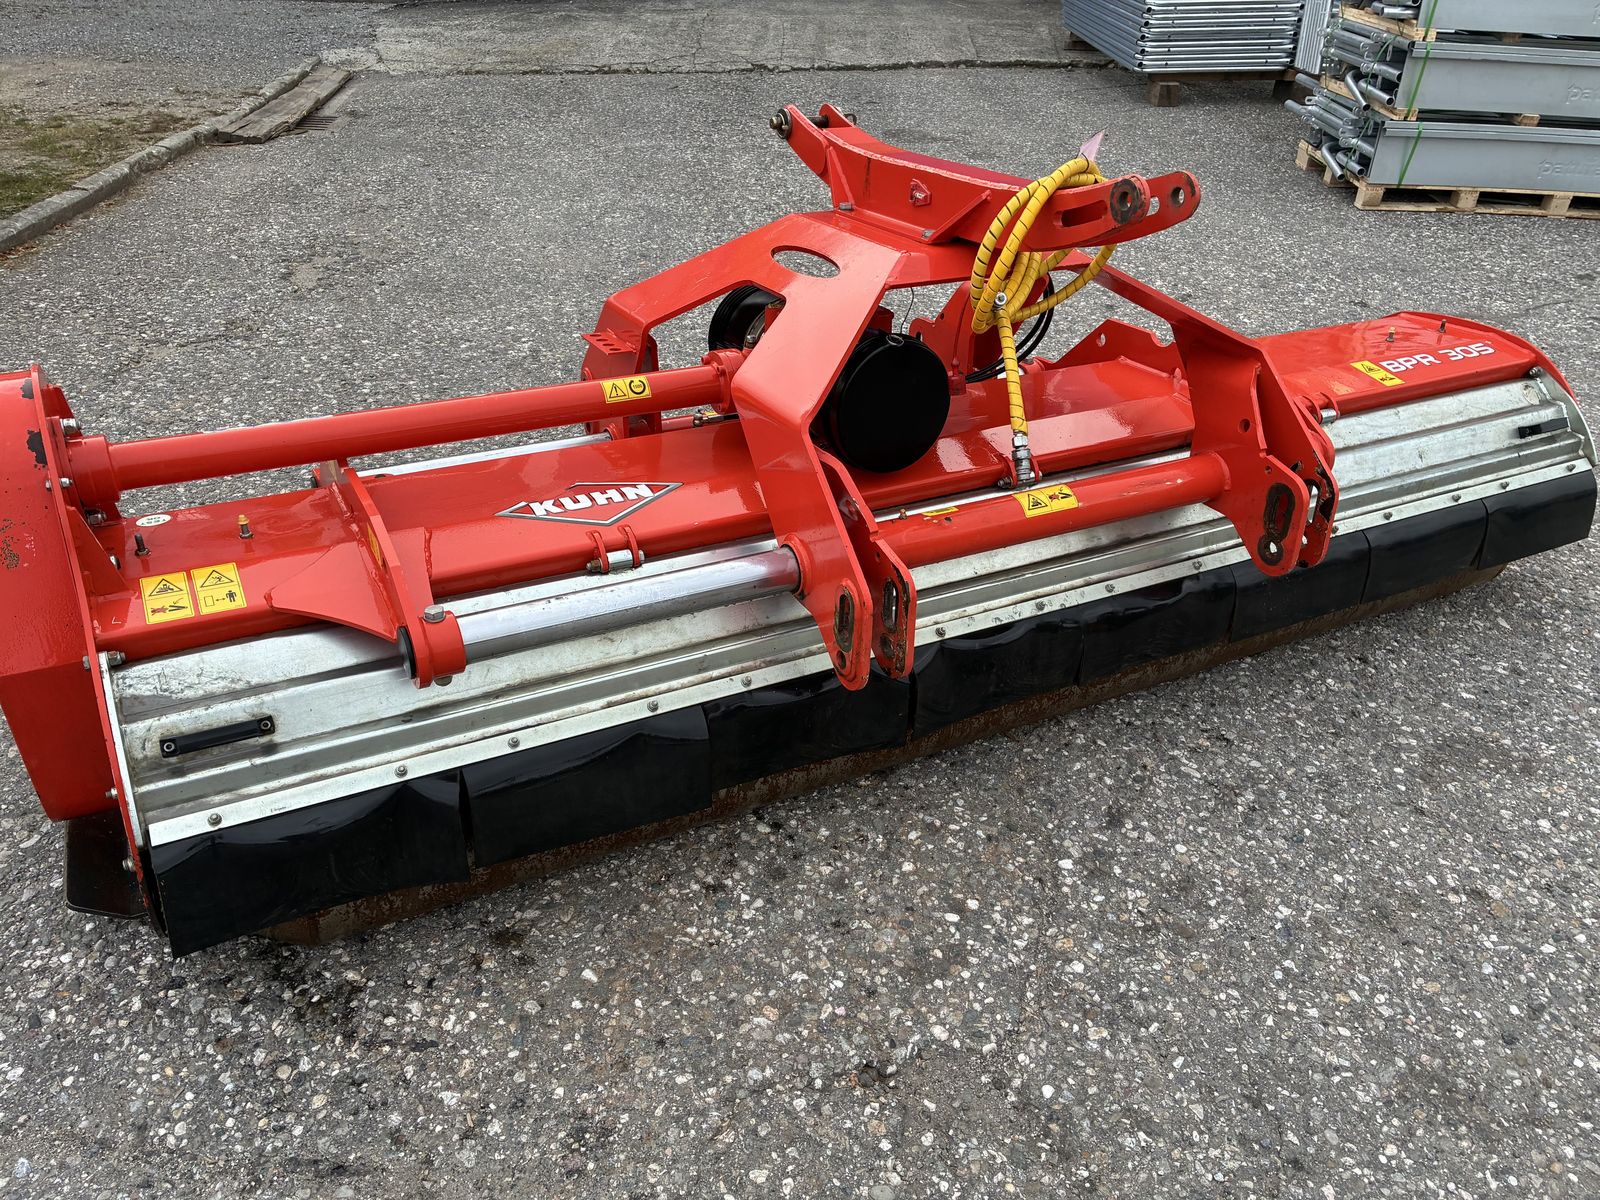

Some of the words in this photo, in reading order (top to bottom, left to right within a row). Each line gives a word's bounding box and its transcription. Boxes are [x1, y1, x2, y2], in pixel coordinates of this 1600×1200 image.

[1379, 353, 1442, 373] BPR
[1437, 342, 1495, 361] 305
[528, 484, 655, 516] KUHN
